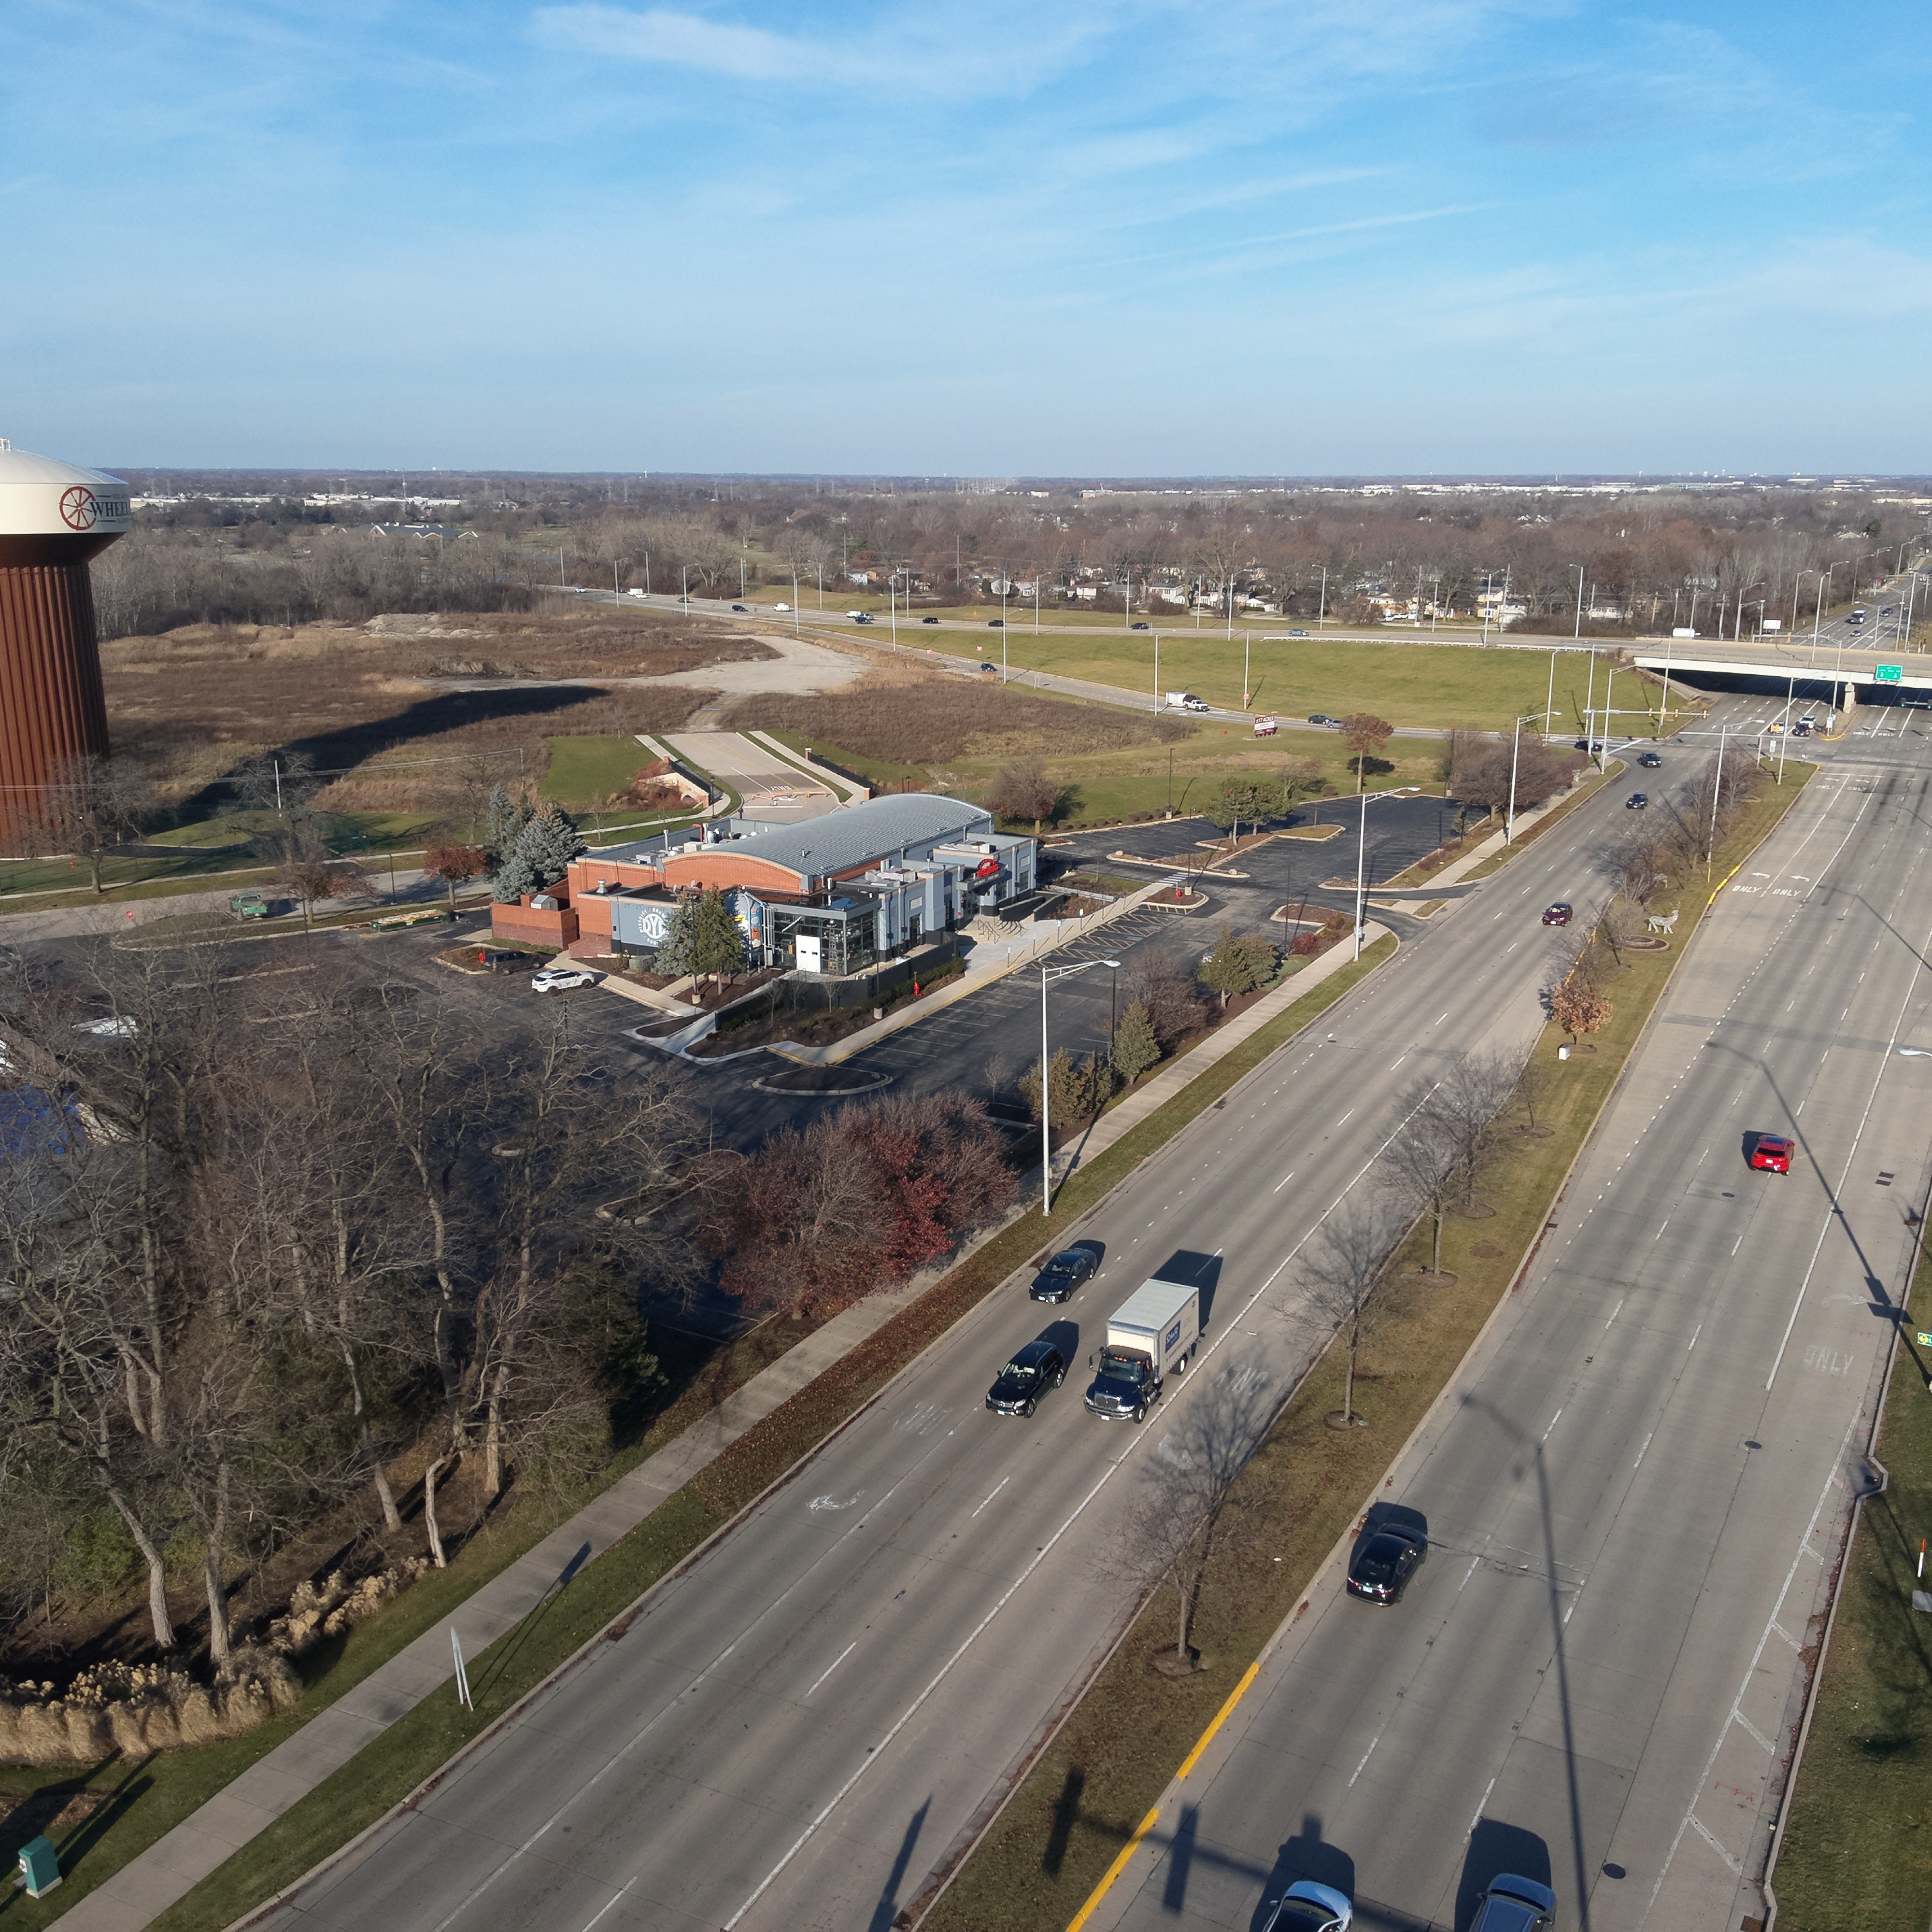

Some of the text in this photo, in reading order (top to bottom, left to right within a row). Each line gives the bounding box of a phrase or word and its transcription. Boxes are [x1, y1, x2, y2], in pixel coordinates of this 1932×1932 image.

[1732, 885, 1762, 894] ONLY
[1772, 888, 1802, 897] ONLY
[1803, 1345, 1854, 1377] ONLY
[1209, 1364, 1269, 1396] ONLY
